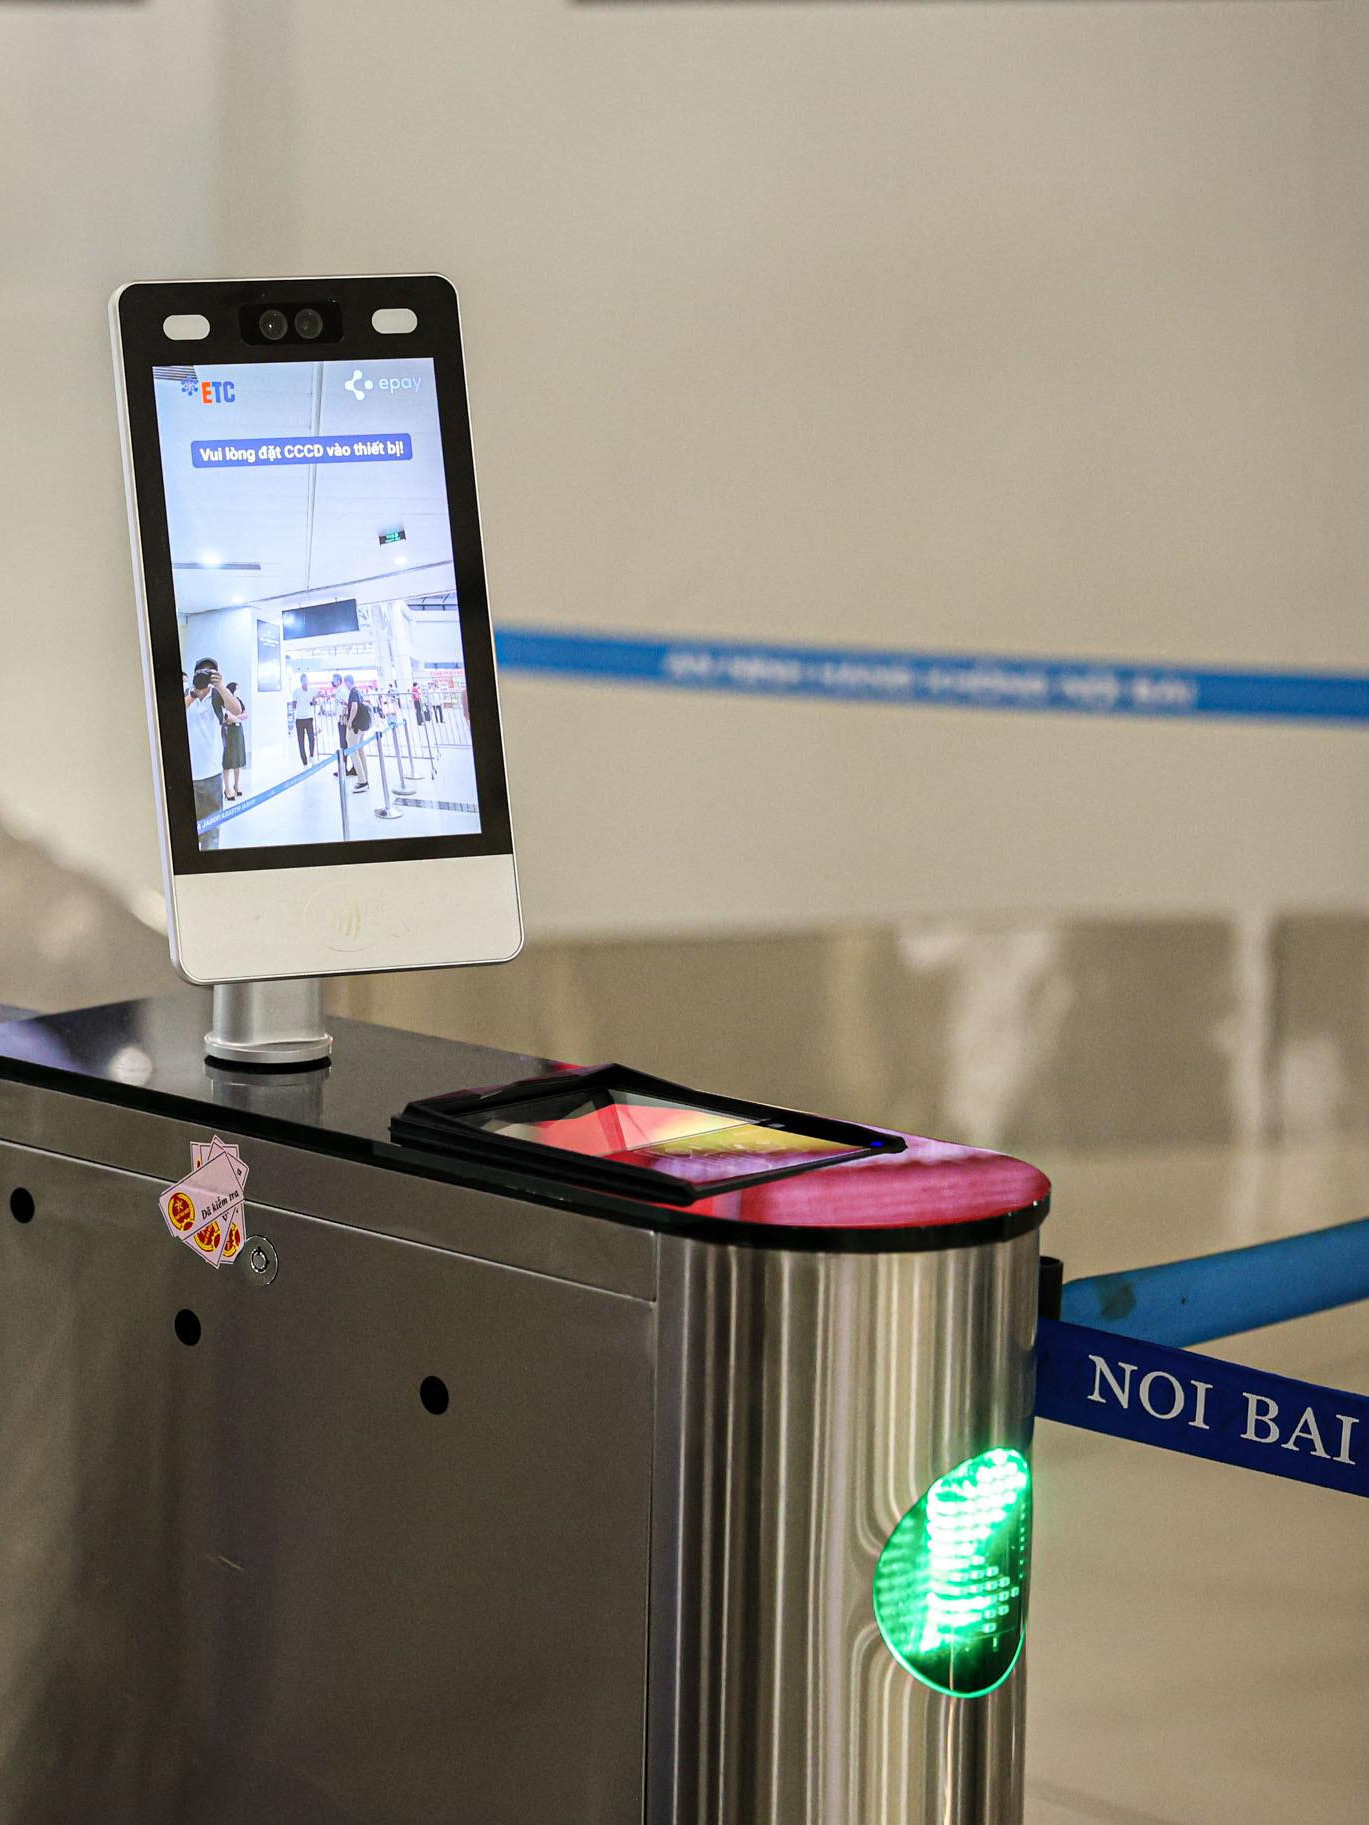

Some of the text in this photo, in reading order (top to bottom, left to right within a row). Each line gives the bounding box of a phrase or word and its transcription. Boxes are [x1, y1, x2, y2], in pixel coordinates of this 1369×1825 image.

[201, 381, 236, 404] ETC
[378, 375, 421, 393] epay
[199, 440, 405, 463] Vui lòng đặt CCCD vào thiết bị!
[1086, 1354, 1360, 1466] NOI BAI
